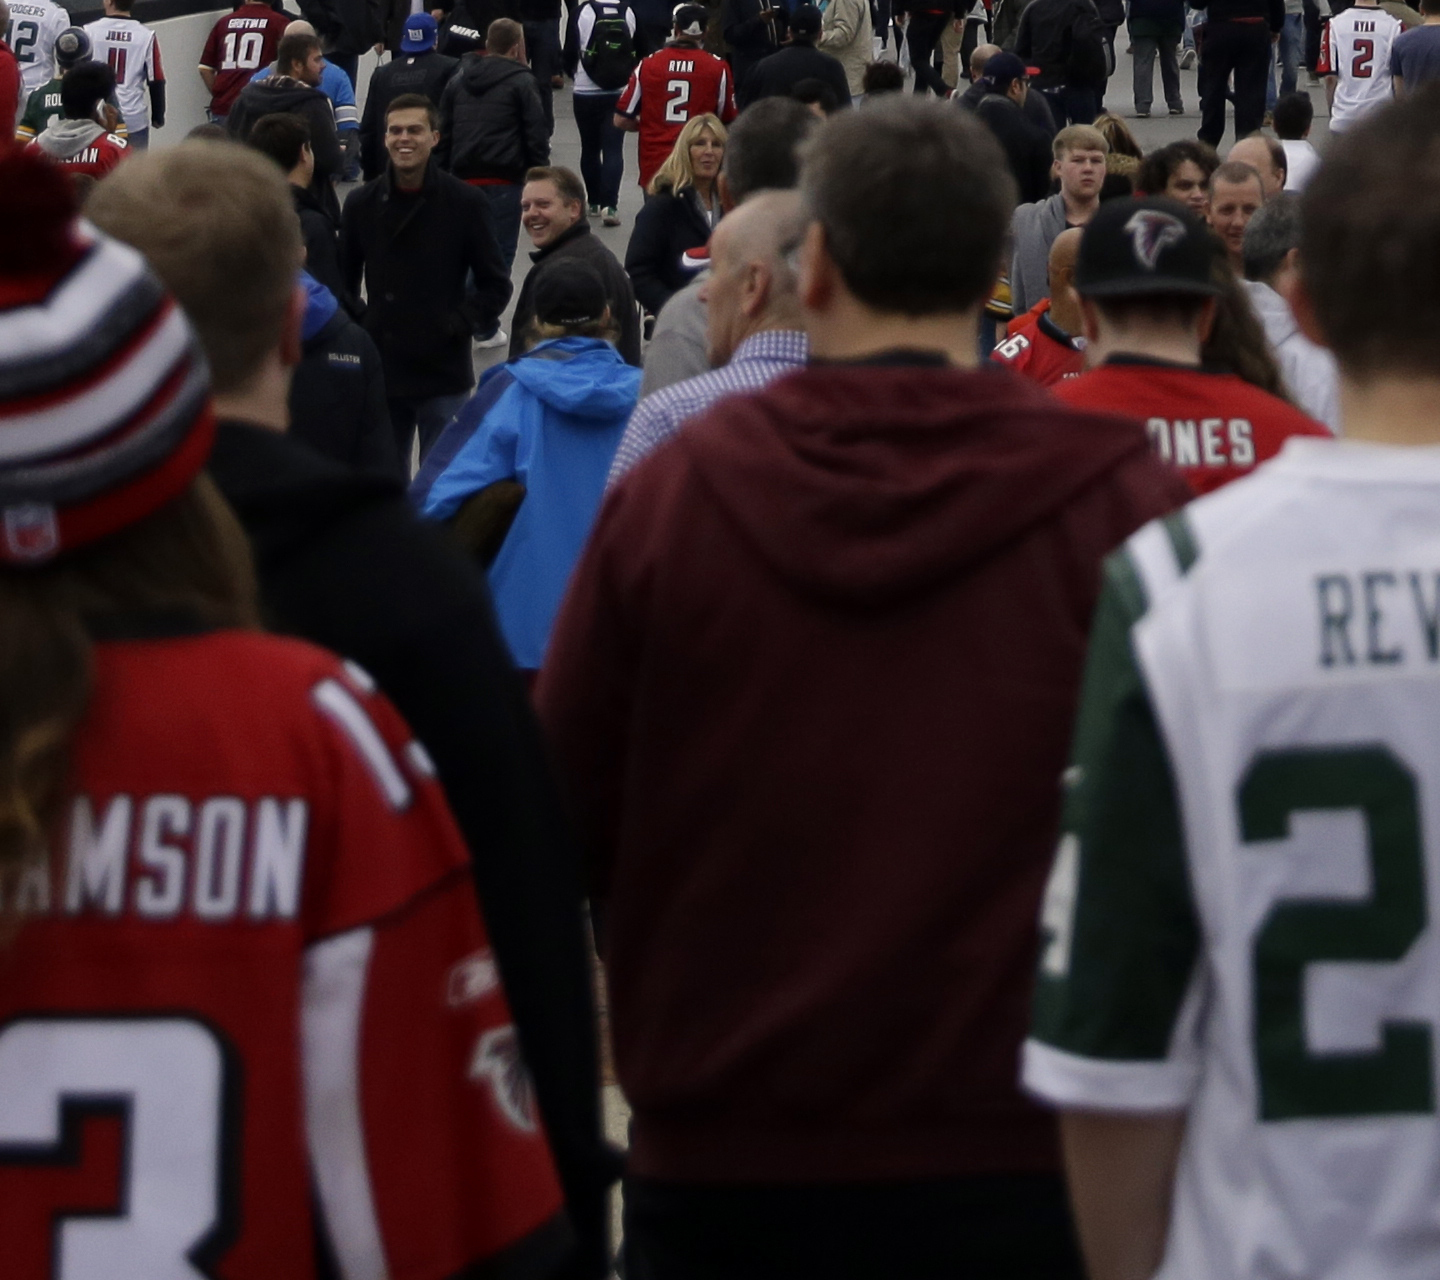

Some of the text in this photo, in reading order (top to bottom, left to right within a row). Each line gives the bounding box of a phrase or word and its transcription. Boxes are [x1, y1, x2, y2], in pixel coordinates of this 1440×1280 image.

[8, 20, 40, 63] 12
[105, 31, 133, 42] JONES
[1353, 20, 1376, 32] RYAN
[108, 47, 127, 84] 11
[221, 32, 264, 70] 10
[669, 60, 694, 72] RYAN
[1351, 38, 1375, 79] 2
[665, 80, 690, 122] 2
[328, 352, 361, 364] HOLLISTER
[1144, 417, 1256, 468] ONES
